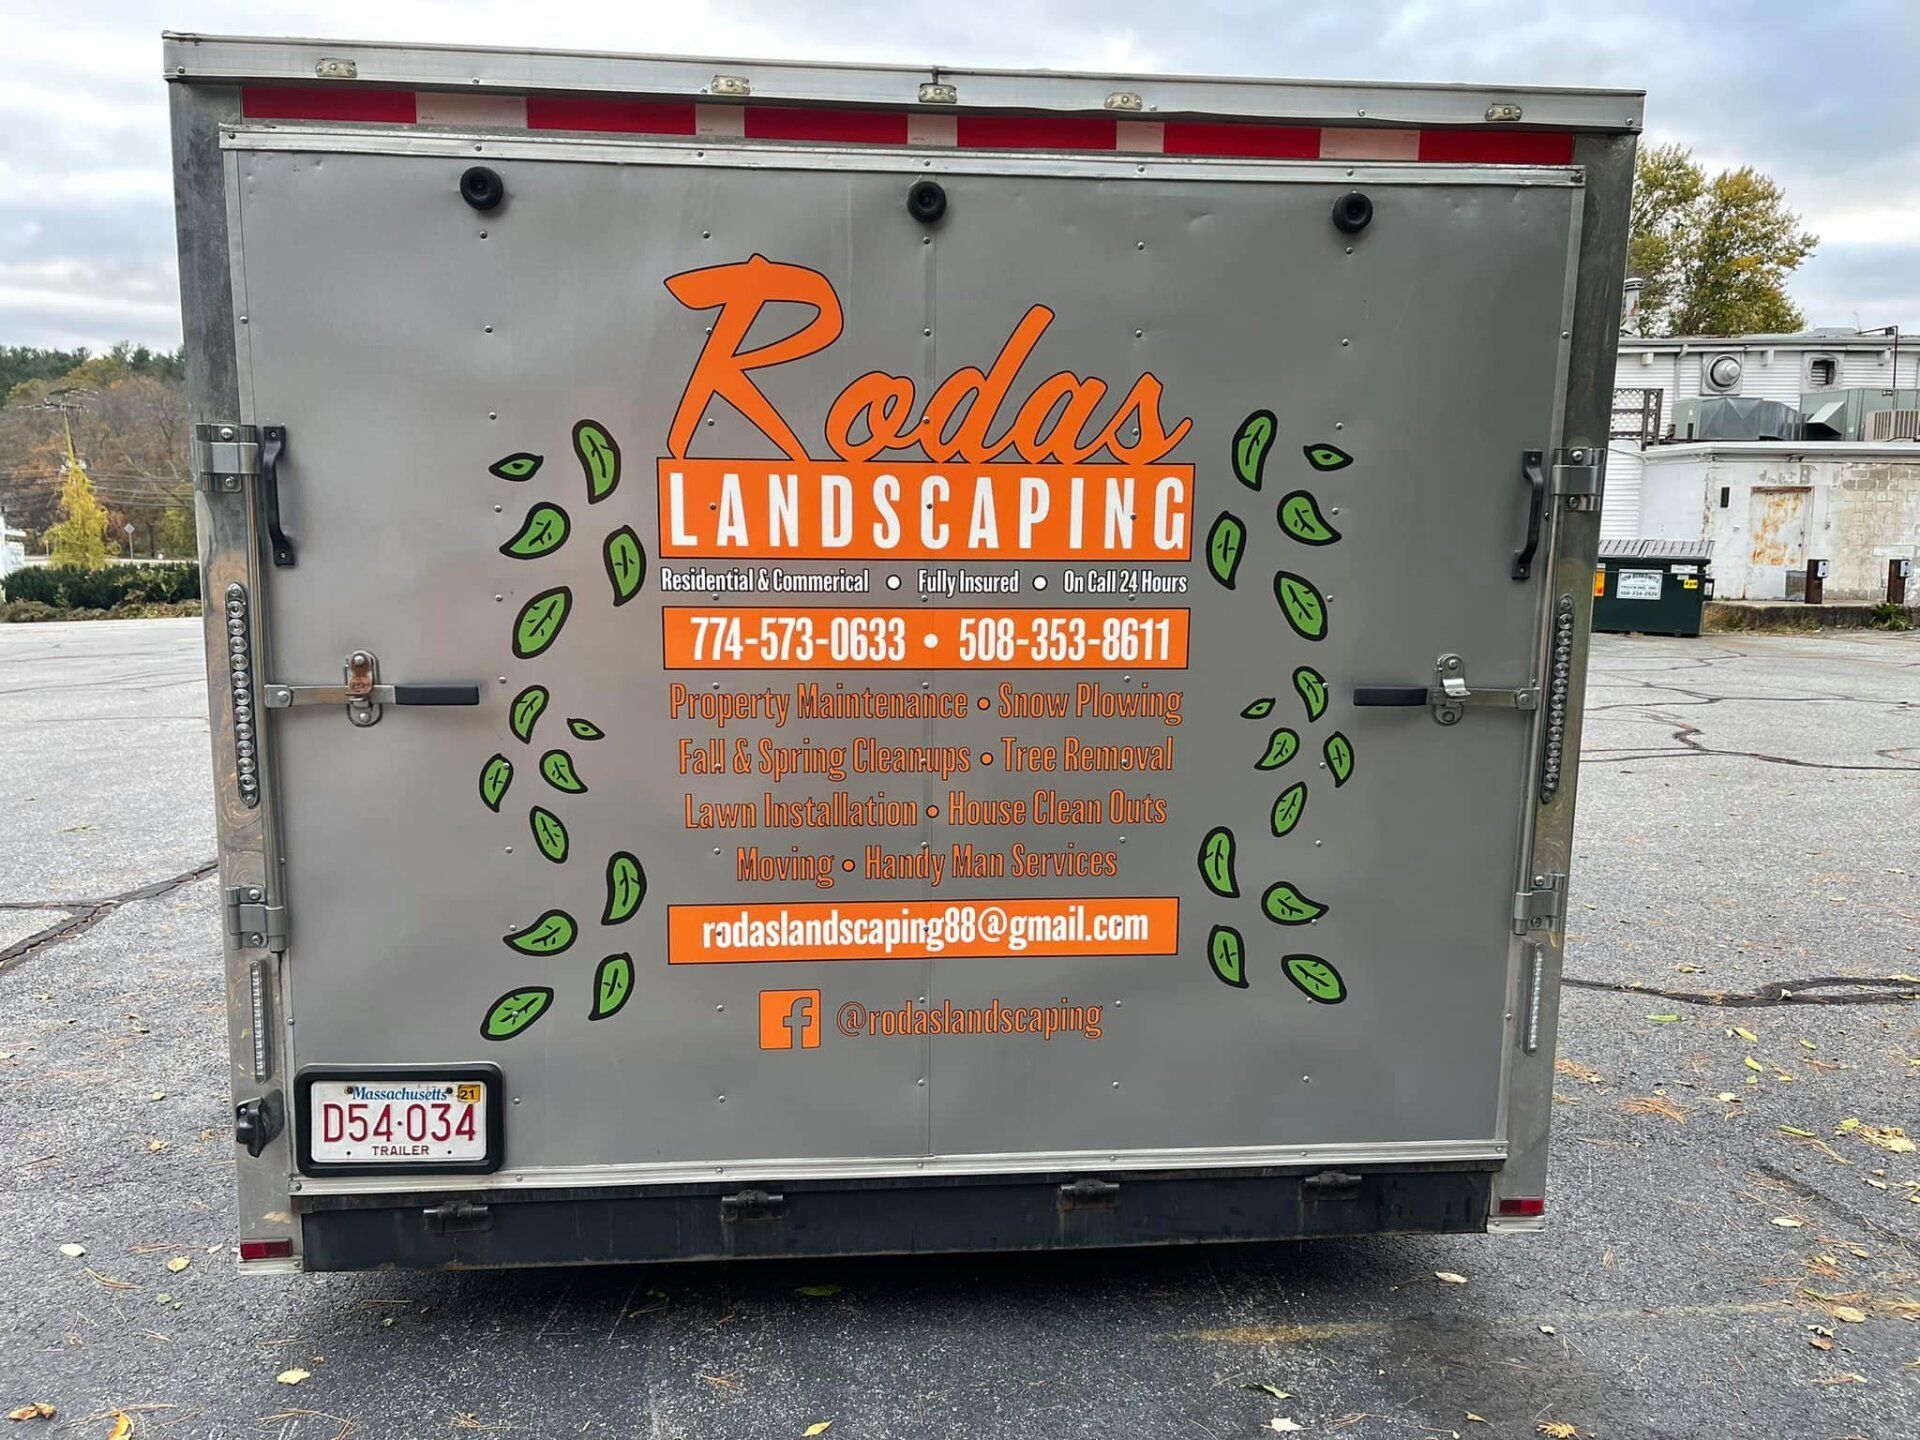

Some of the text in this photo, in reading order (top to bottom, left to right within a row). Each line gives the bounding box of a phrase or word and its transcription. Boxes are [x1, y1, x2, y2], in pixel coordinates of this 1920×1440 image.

[664, 253, 1192, 464] Rodas
[669, 472, 1185, 550] LANDSCAPING
[660, 567, 1188, 598] Residential & Commerical Fully Insured On Call 24 Hours
[690, 617, 1171, 661] 774-573-0633 508-353-8611
[670, 682, 1184, 728] Property Maintenance Snow Plowing
[679, 736, 1174, 782] Fall & Spring Cleanups Tree Removal
[684, 789, 1168, 828] Lawn Installation House Clean Outs
[736, 842, 1118, 889] Moving Handy Man Services
[702, 905, 1149, 953] rodaslandscaping88@gmail.com
[836, 997, 1104, 1041] @rodaslandscaping
[352, 1085, 448, 1101] Massachusetts
[459, 1090, 475, 1100] 21
[372, 1145, 429, 1156] TRAILER
